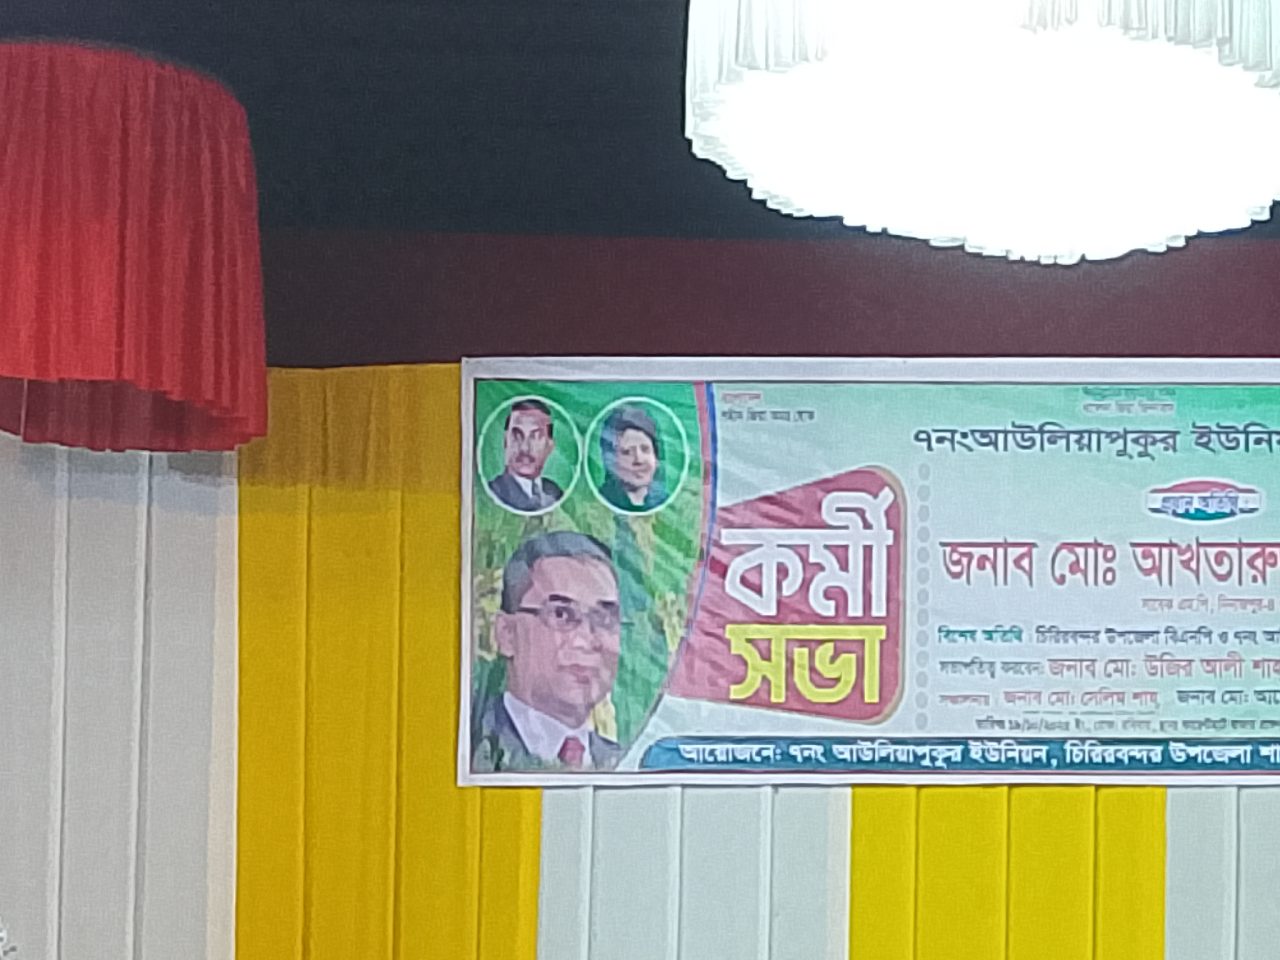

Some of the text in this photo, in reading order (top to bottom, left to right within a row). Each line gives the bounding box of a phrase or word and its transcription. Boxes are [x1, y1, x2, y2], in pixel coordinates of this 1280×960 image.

[720, 486, 895, 617] কর্মী
[939, 537, 1037, 587] জনাব
[1051, 537, 1116, 586] মোঃ
[725, 624, 887, 703] সভা
[1047, 659, 1097, 679] জনাব
[1201, 651, 1245, 680] আলী
[1003, 690, 1042, 705] জনাব
[1176, 690, 1216, 705] জনাব
[1169, 741, 1252, 764] উপজেলা
